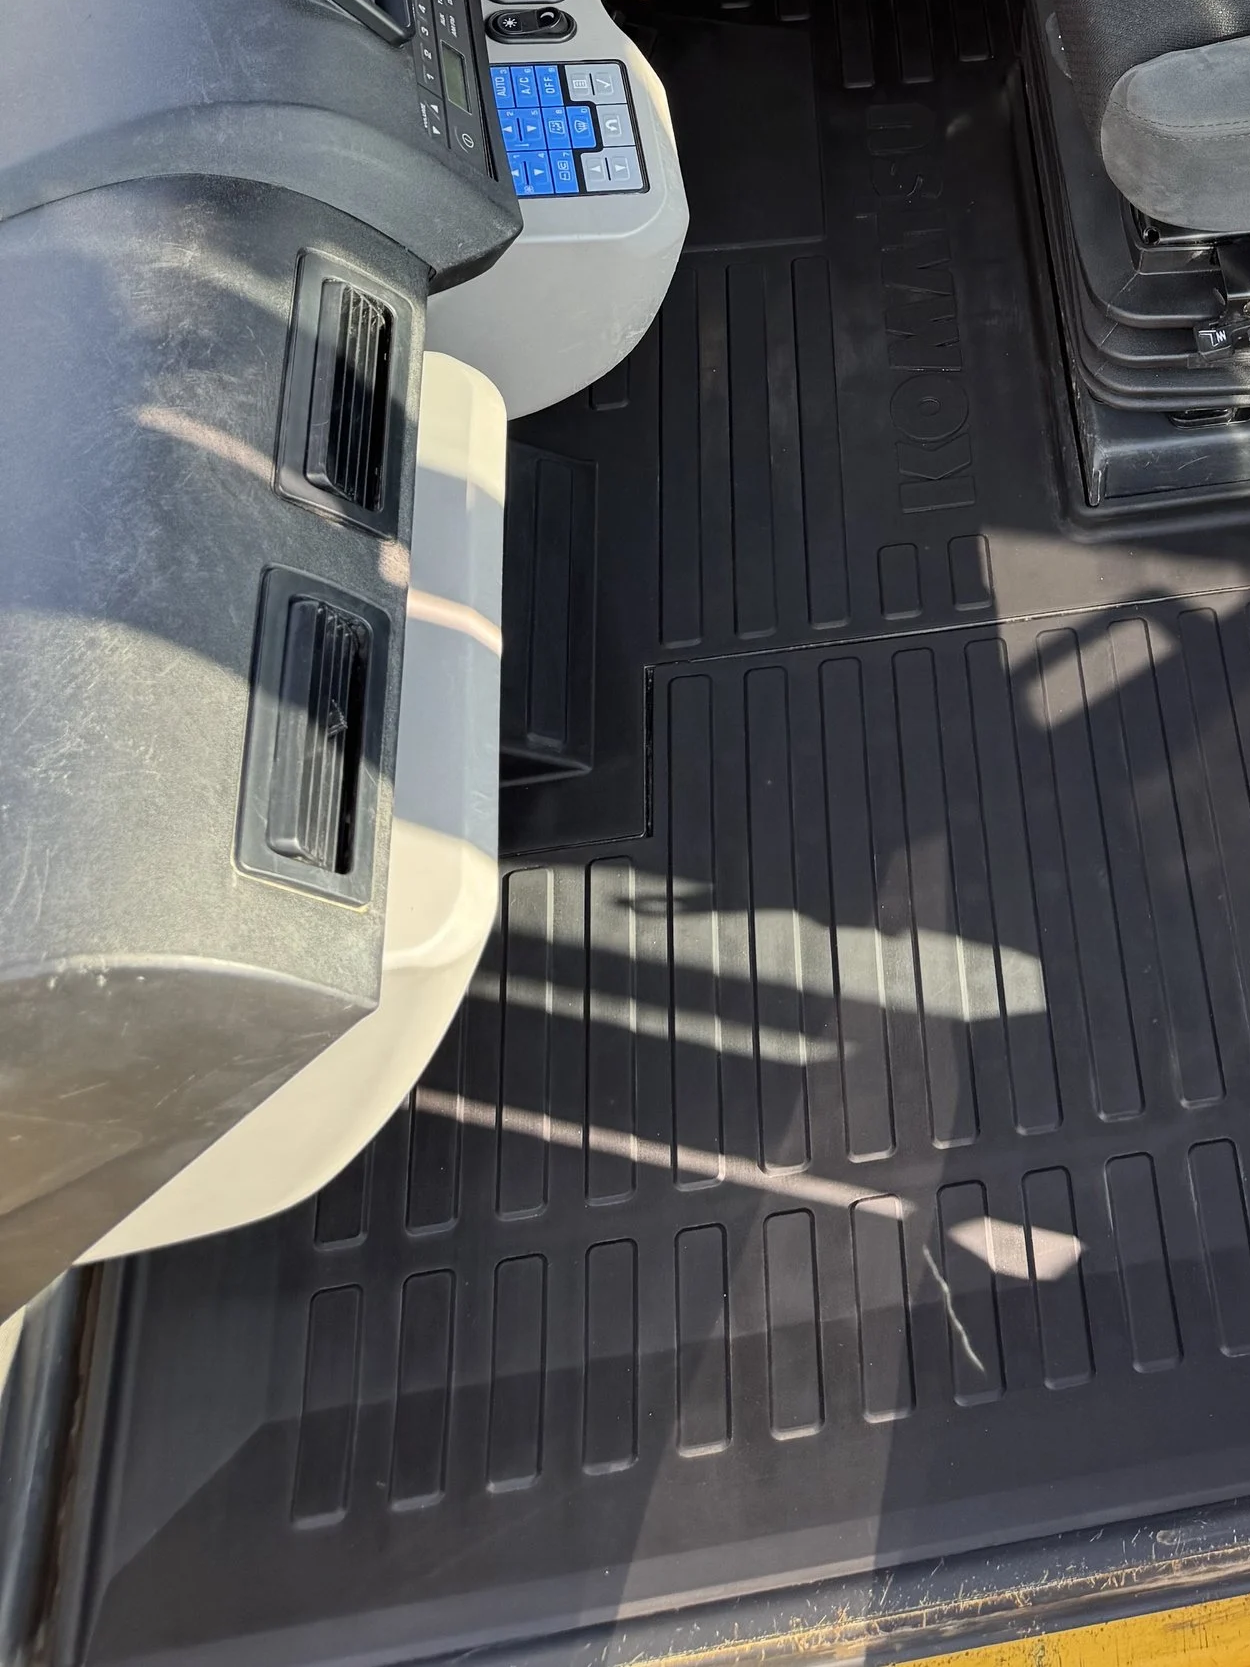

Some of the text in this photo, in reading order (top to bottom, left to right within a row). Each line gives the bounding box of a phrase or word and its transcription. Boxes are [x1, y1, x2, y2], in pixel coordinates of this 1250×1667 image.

[418, 3, 425, 14] 4
[421, 26, 428, 36] 3
[424, 49, 431, 59] 2
[496, 76, 506, 97] AUTO
[520, 77, 531, 95] A/C
[544, 76, 555, 94] OFF
[858, 100, 976, 514] KOMATSU
